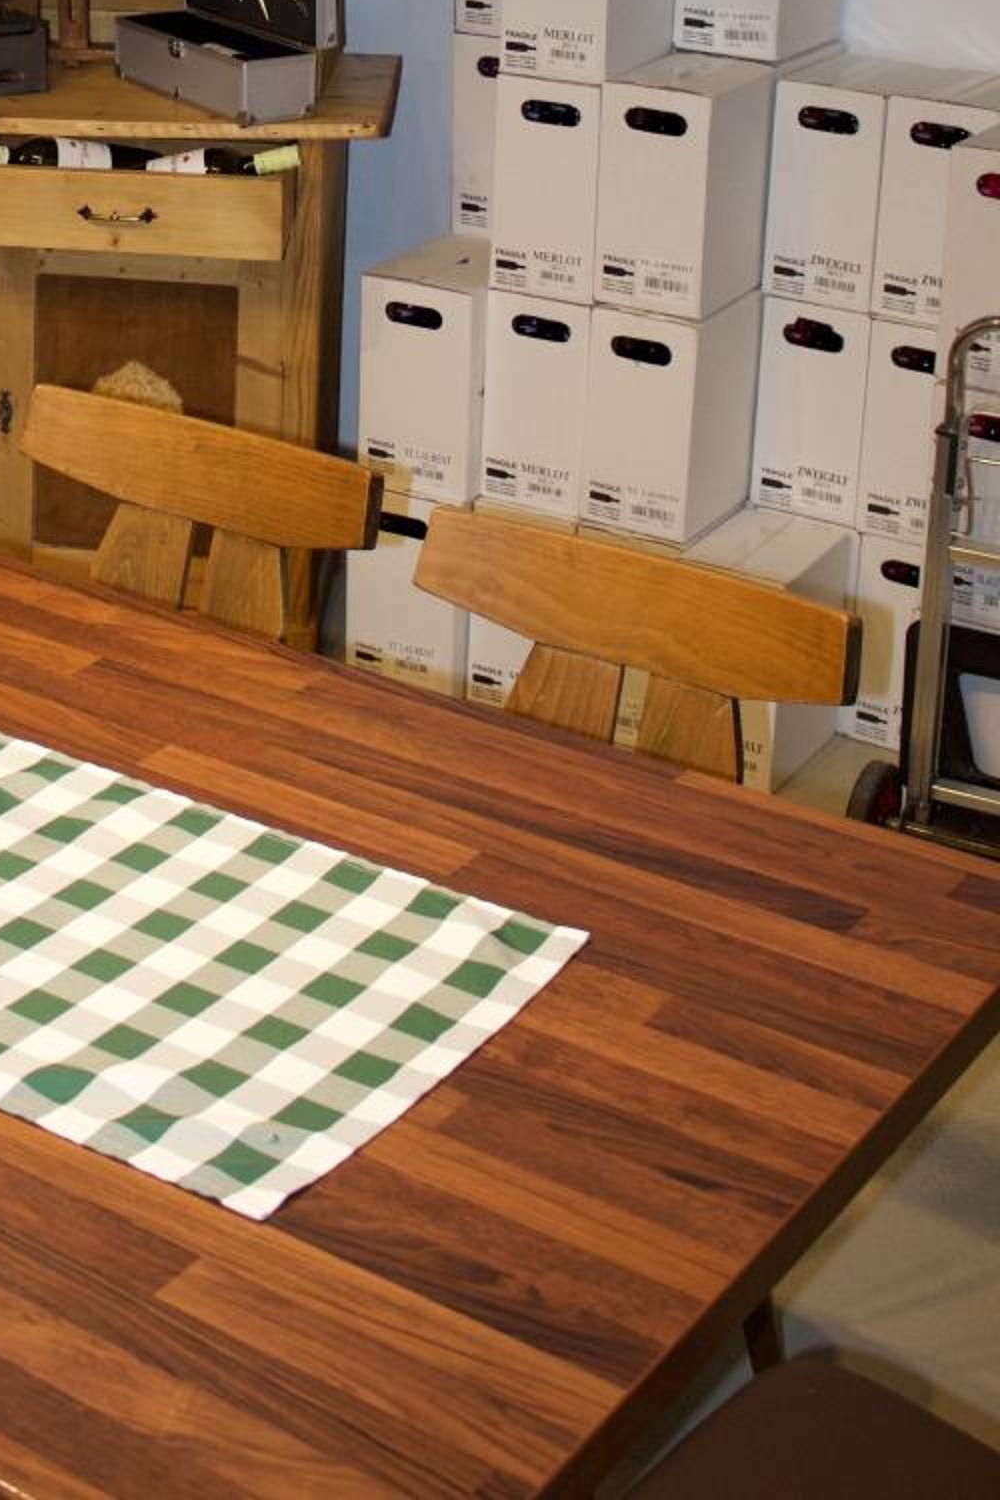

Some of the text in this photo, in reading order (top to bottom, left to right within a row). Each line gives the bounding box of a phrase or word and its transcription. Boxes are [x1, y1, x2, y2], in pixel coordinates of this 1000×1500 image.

[543, 27, 595, 45] MERLOT
[533, 250, 583, 267] MERLOT
[520, 461, 570, 481] MERLOT
[797, 466, 848, 486] ZWEIGELT
